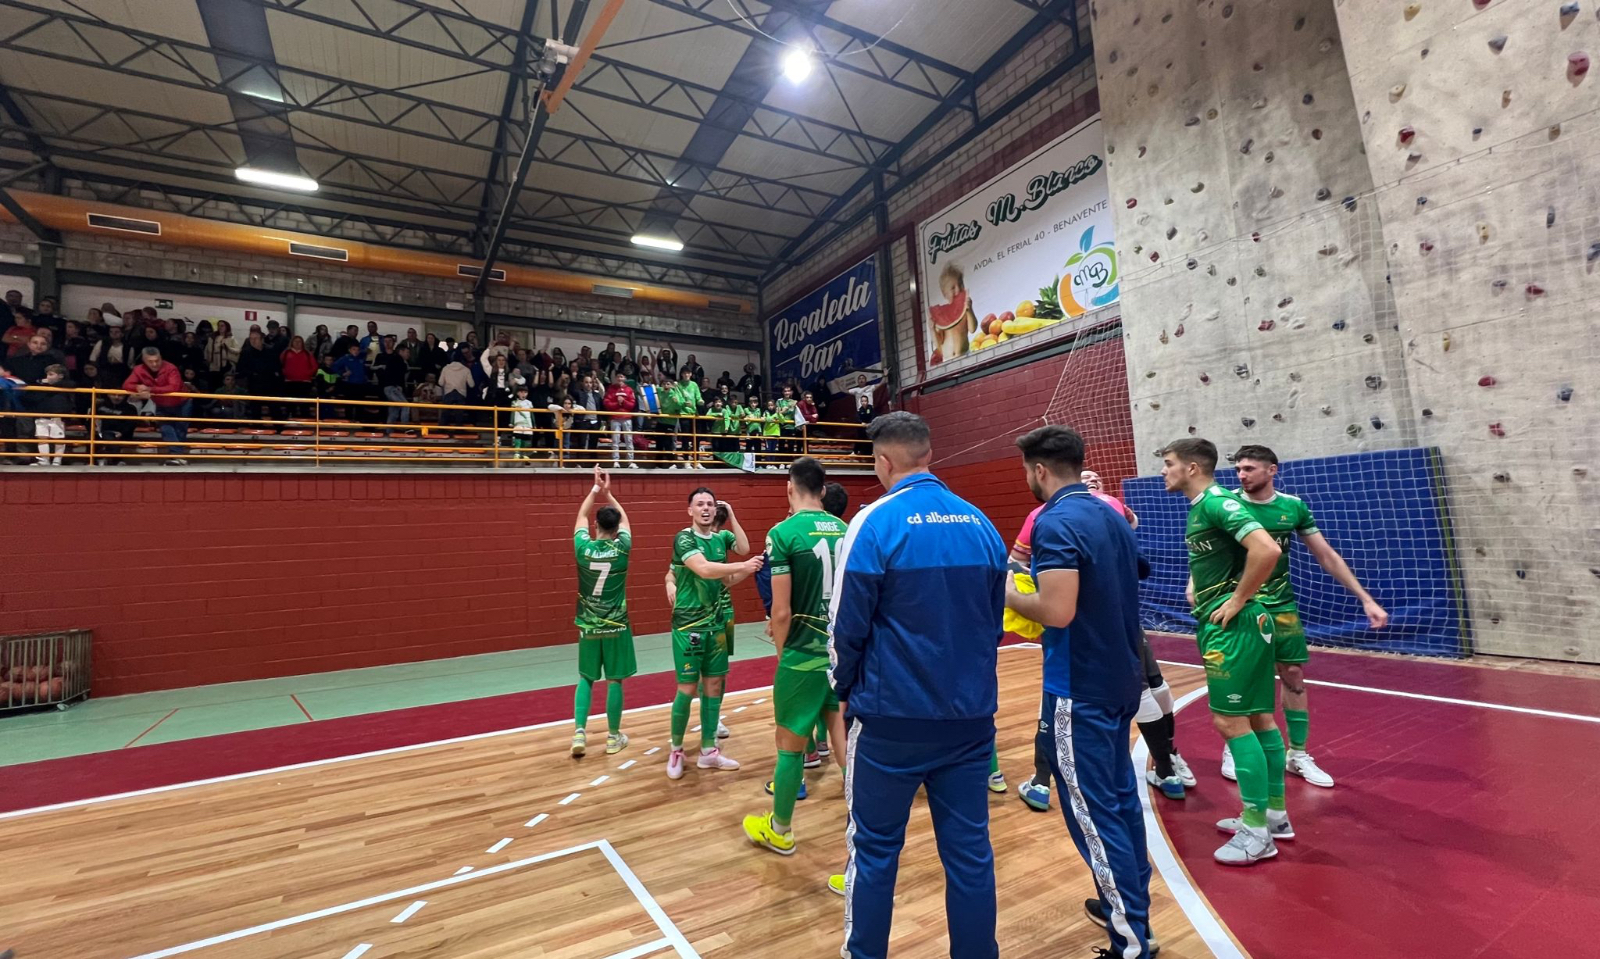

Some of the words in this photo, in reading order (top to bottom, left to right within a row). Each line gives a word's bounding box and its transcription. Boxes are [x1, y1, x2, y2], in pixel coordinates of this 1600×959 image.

[928, 219, 982, 264] Frutas
[1024, 154, 1103, 212] Blanco
[973, 257, 995, 272] AVDA.
[997, 249, 1006, 260] EL
[1006, 239, 1032, 256] FERIAL
[1034, 230, 1045, 242] 40
[1053, 199, 1108, 233] BENAVENTE
[774, 276, 872, 352] Rosaleda
[799, 339, 843, 379] Bar
[813, 520, 841, 532] JORGE
[907, 512, 923, 524] cd
[925, 511, 970, 524] albense
[589, 561, 612, 596] 7
